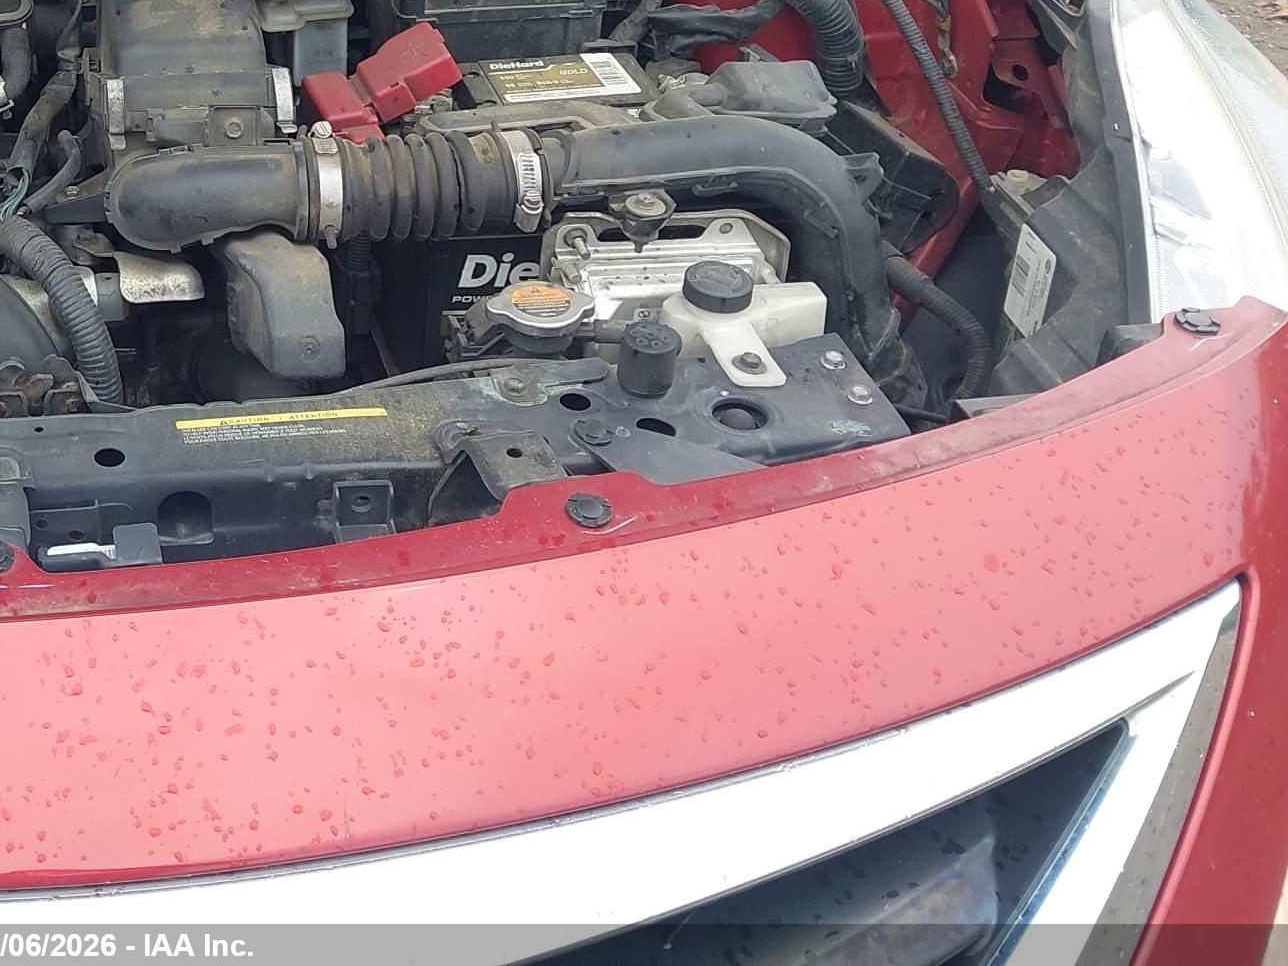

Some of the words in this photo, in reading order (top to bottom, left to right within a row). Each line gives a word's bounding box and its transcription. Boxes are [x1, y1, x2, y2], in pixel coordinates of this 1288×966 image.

[489, 60, 545, 70] DieHard
[228, 417, 270, 425] CAUTION
[289, 412, 338, 420] ATTENTION
